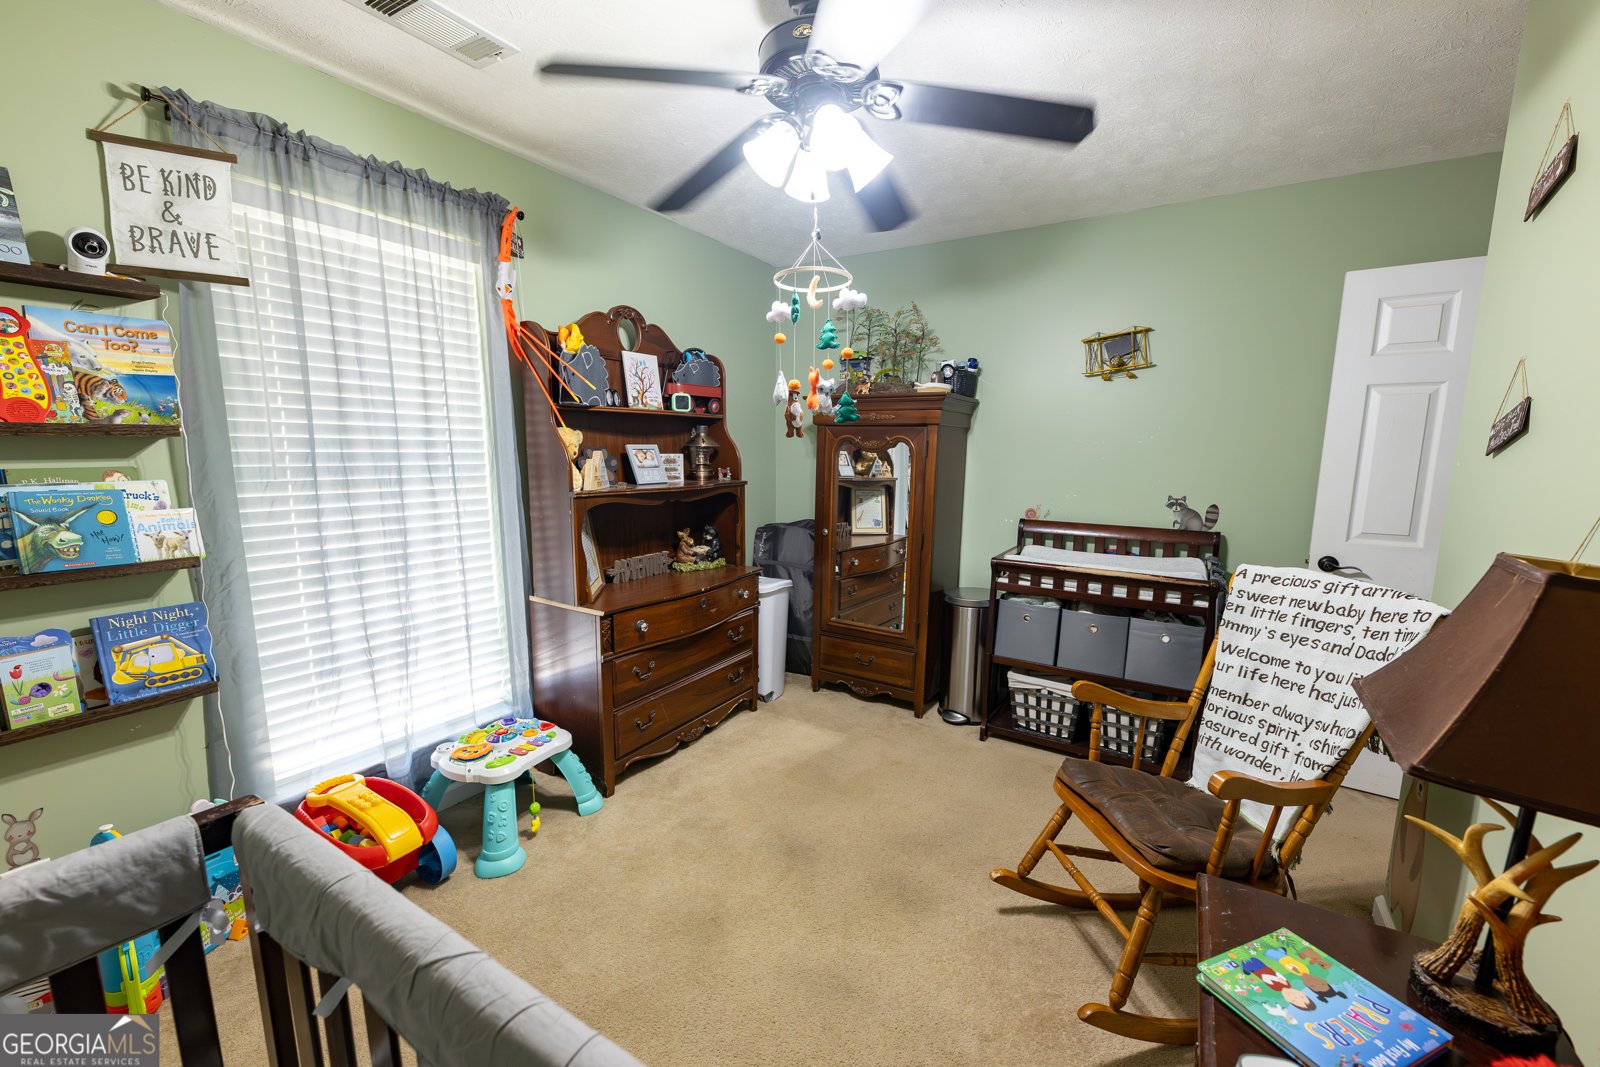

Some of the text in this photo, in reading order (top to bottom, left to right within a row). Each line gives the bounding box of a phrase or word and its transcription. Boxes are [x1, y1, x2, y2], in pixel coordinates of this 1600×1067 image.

[119, 162, 151, 194] BE
[162, 201, 182, 225] &
[129, 225, 221, 261] BRAVE
[63, 320, 158, 341] Can I Come
[101, 338, 139, 353] Too?
[41, 495, 75, 507] Wonky
[77, 495, 114, 506] Donkey
[126, 501, 145, 511] ime
[136, 520, 197, 533] Animals
[1235, 568, 1420, 600] A precious gift arrive
[108, 607, 194, 630] Night Night,
[1236, 589, 1287, 606] sweet
[1369, 606, 1409, 623] here
[1412, 609, 1433, 623] to
[106, 626, 148, 642] Little
[153, 618, 200, 634] Digger
[1219, 618, 1277, 641] ommy's
[1280, 632, 1321, 649] eyes
[1321, 641, 1355, 657] and
[1225, 601, 1420, 648] en little fingers, ten tiny
[1221, 641, 1291, 669] Welcome
[1295, 661, 1312, 675] to
[1313, 668, 1345, 684] you
[1216, 660, 1234, 673] ur
[1237, 665, 1268, 683] life
[1270, 671, 1306, 694] here
[1308, 684, 1337, 703] has
[1210, 685, 1270, 711] member
[1205, 699, 1256, 725] lorious
[1200, 716, 1260, 746] easured
[1260, 740, 1289, 759] gift
[1304, 993, 1392, 1050] PRAYERS
[1384, 1044, 1412, 1062] First
[1396, 1038, 1421, 1052] My
